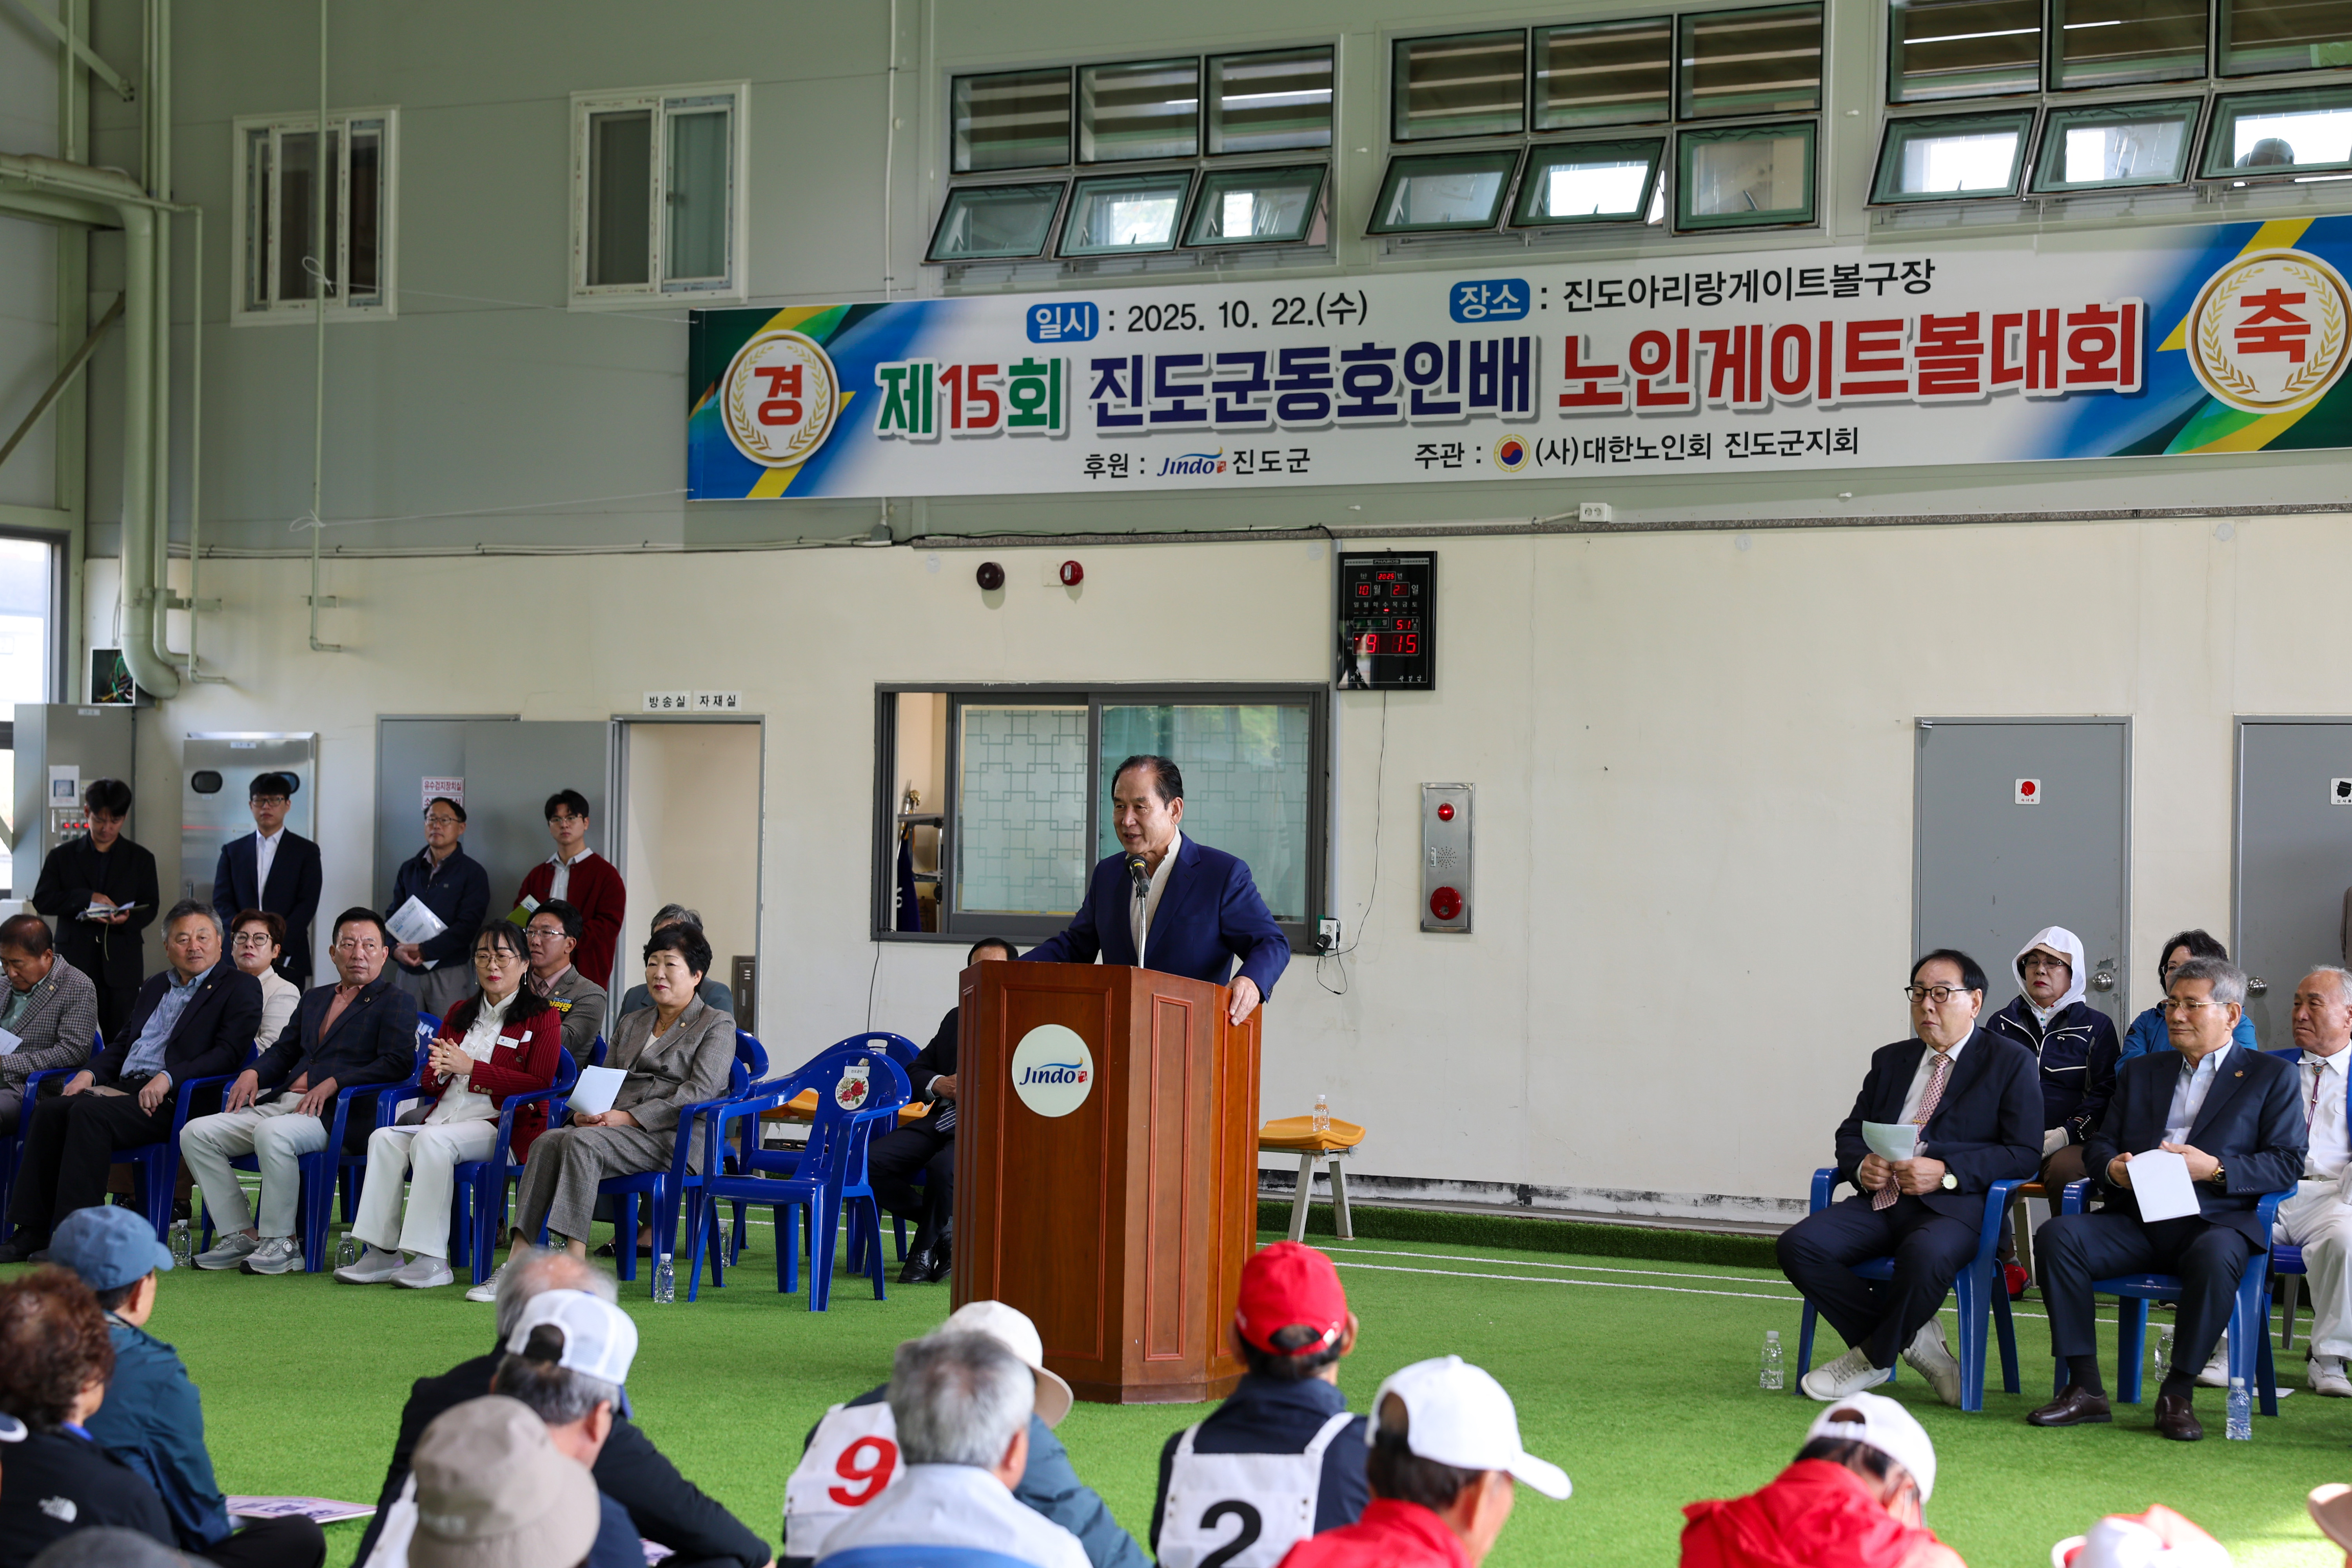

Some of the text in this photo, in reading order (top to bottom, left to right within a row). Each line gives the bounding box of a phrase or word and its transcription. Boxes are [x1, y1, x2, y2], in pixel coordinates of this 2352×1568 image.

[1459, 285, 1520, 318] 장소
[1564, 259, 1935, 312] 진도아리랑게이트볼구장
[1036, 306, 1089, 338] 일시
[1128, 303, 1204, 332] 2025.
[1219, 301, 1257, 328] 10.
[1272, 290, 1367, 327] 22.(수)
[2235, 289, 2310, 362] 축
[880, 304, 2136, 433] 제15회 진도군동호인배 노인게이트볼대회
[755, 365, 802, 425] 경
[1084, 454, 1128, 479] 후원
[1158, 458, 1214, 475] Jindo
[1233, 448, 1310, 474] 진도군
[1415, 442, 1465, 469] 주관
[1536, 433, 1710, 466] (사)대한노인회
[1725, 427, 1857, 458] 진도군지회
[1359, 585, 1369, 595] 10
[1411, 584, 1419, 593] 일
[1367, 634, 1417, 653] 9 15
[1396, 620, 1411, 630] 51
[650, 696, 685, 708] 방송실
[700, 695, 735, 707] 자재실
[1020, 1067, 1075, 1084] Jindo
[829, 1436, 897, 1506] 9
[1197, 1500, 1261, 1568] 2
